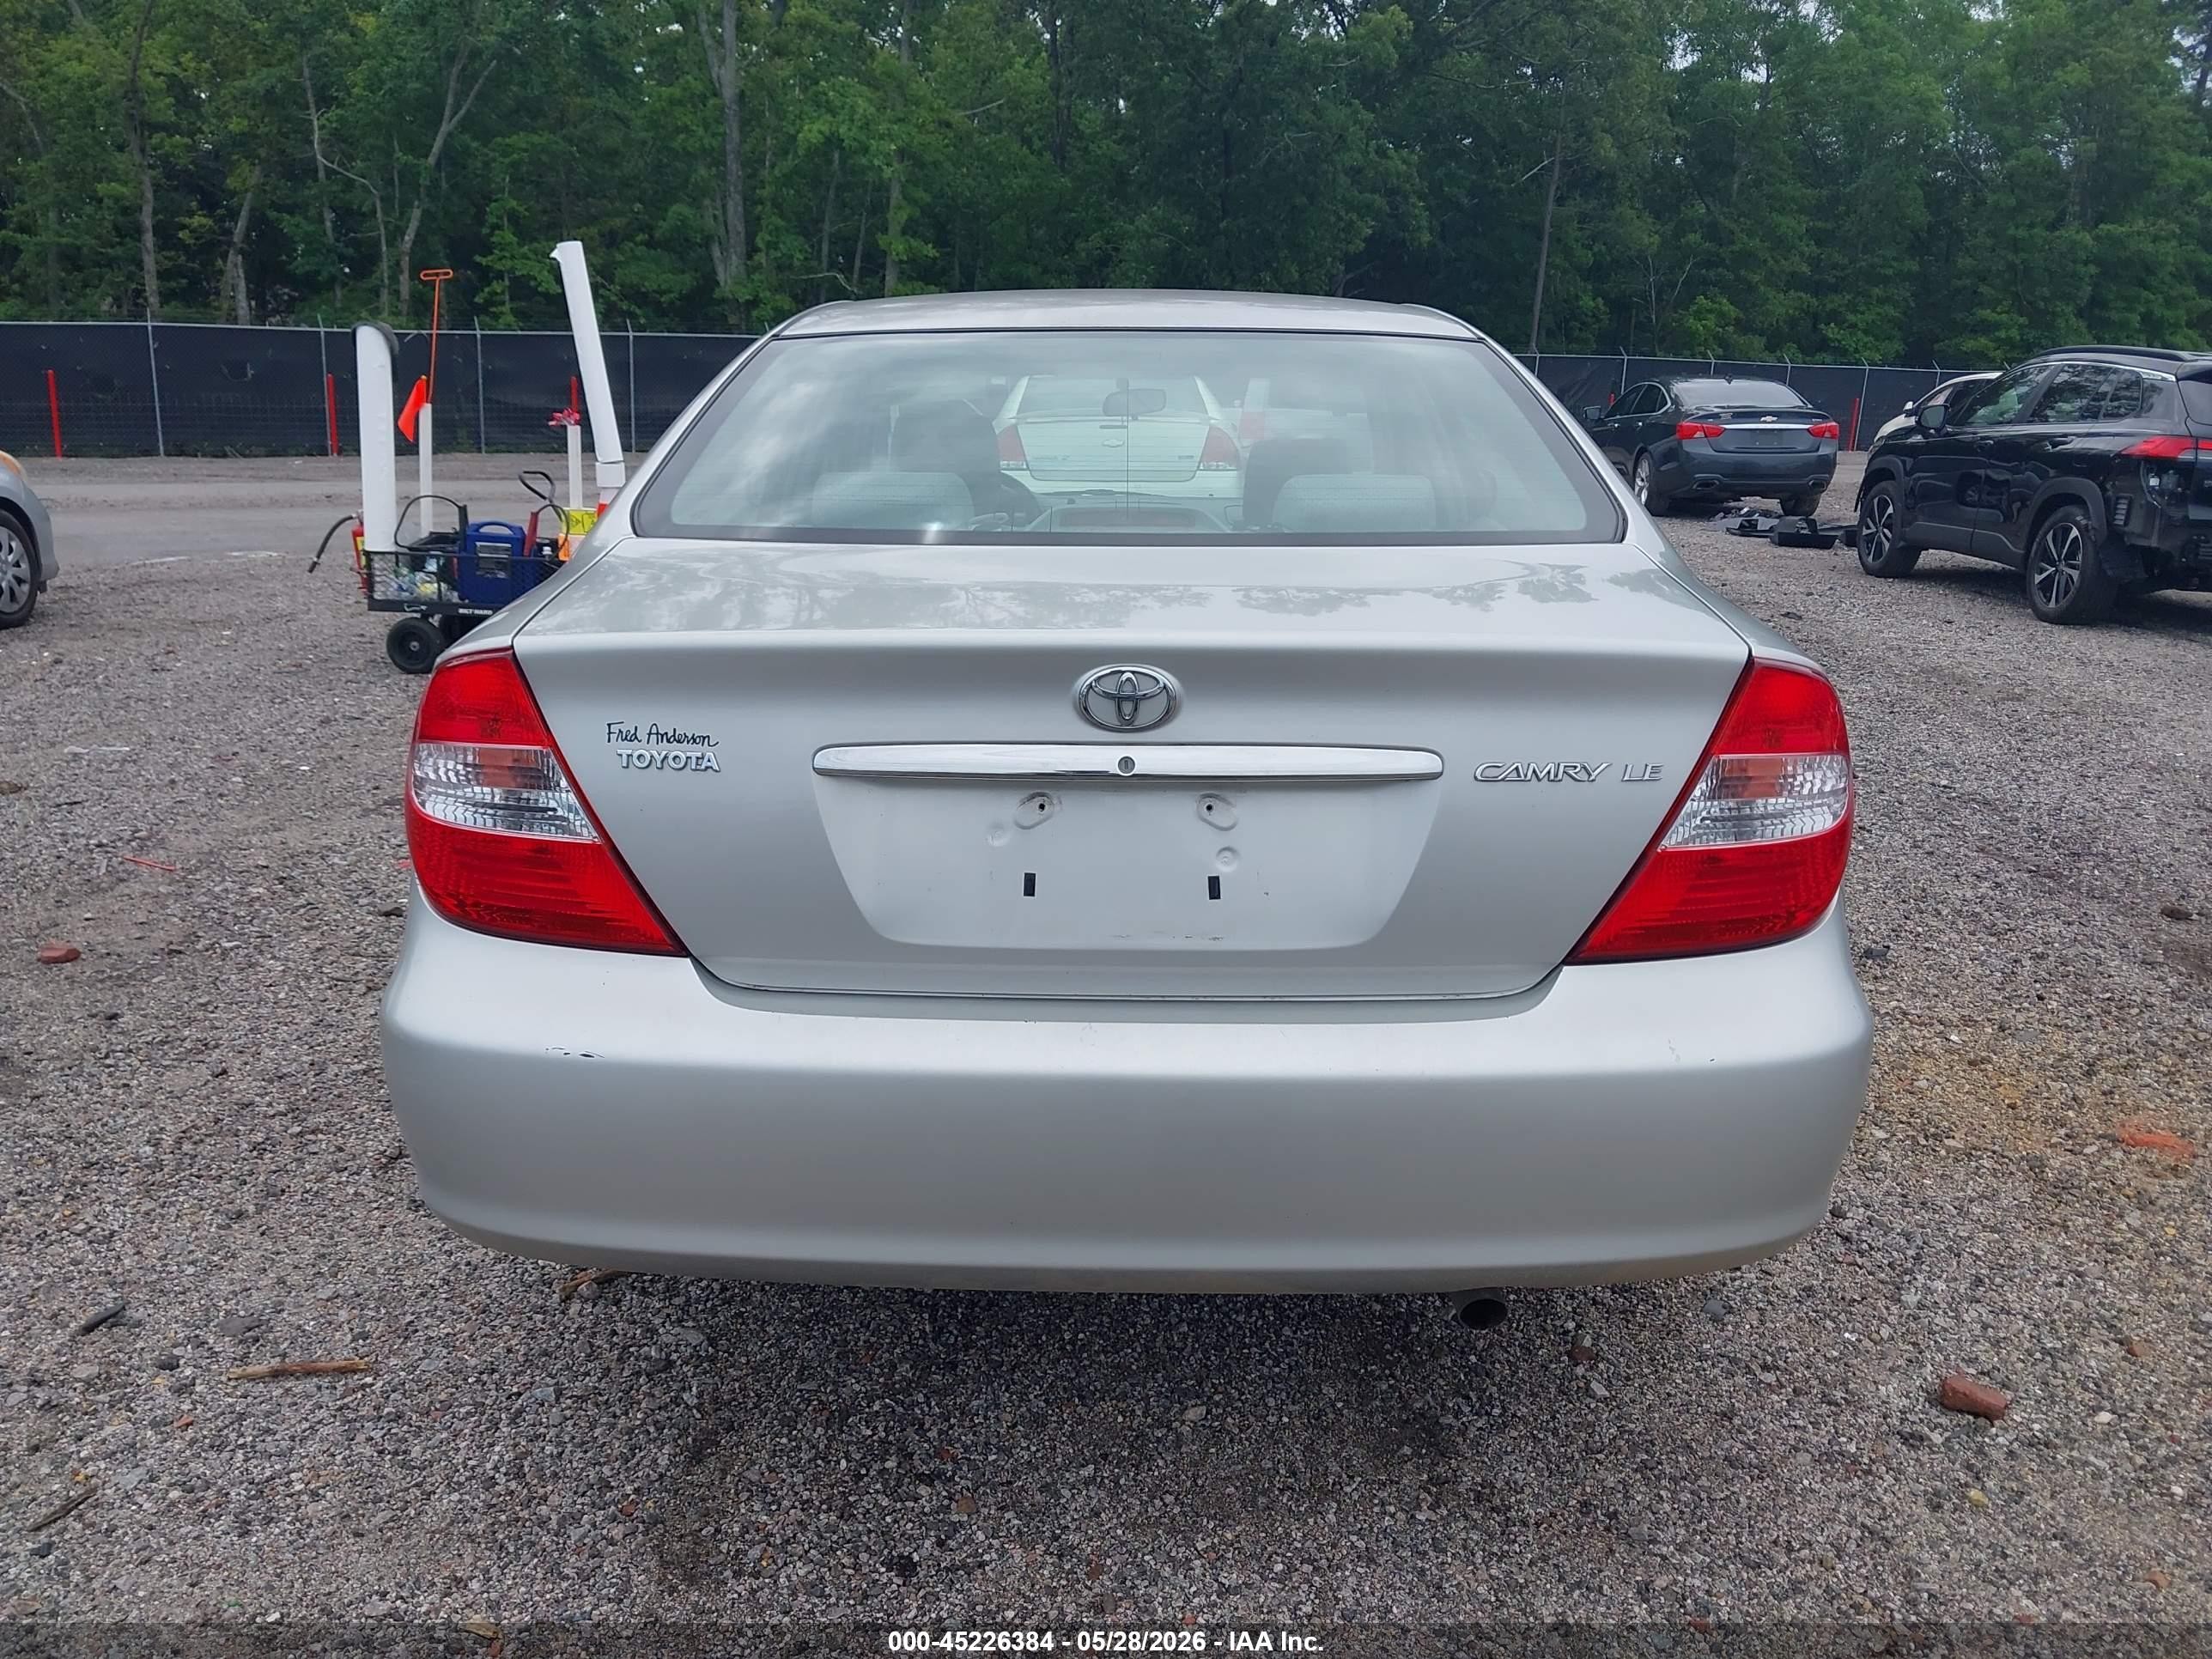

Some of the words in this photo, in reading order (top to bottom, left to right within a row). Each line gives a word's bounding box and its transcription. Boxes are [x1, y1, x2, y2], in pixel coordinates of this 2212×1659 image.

[606, 721, 642, 744] Fred
[647, 723, 720, 747] Anderson
[617, 749, 721, 773] TOYOTA
[1474, 762, 1613, 782] CAMRY
[1621, 763, 1664, 782] LE
